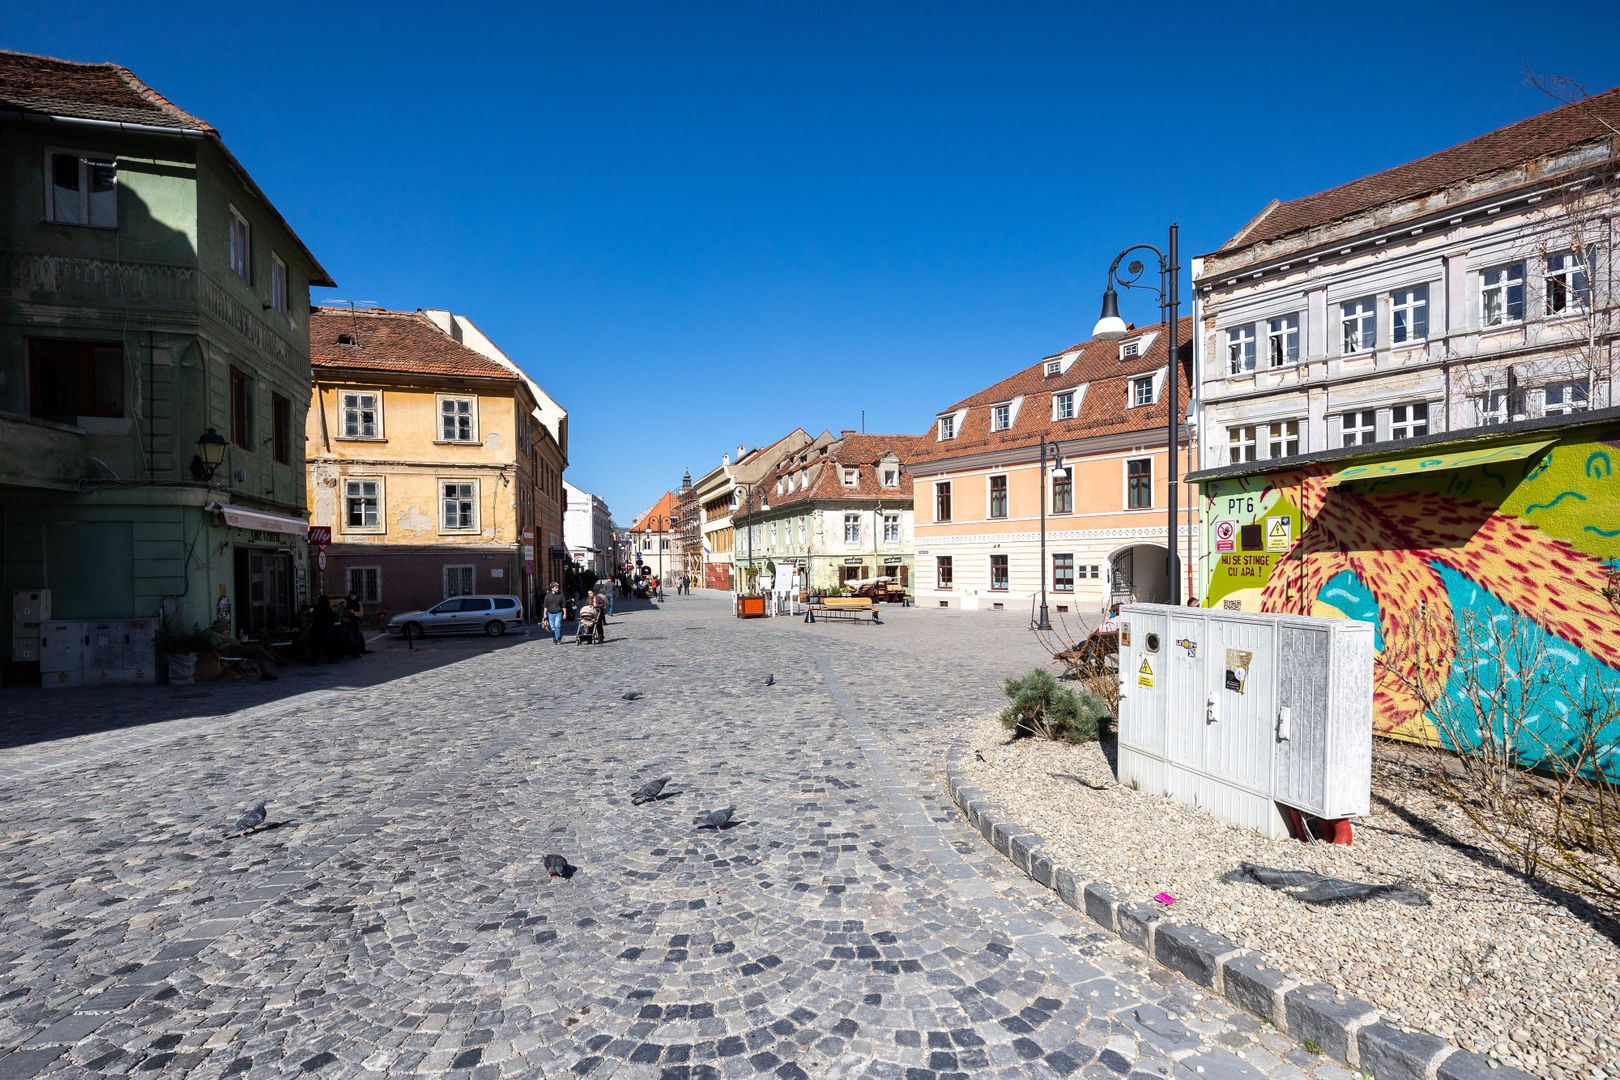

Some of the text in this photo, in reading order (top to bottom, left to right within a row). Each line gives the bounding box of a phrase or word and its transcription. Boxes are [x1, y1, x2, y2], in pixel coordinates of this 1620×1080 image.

[310, 528, 330, 543] illy
[1222, 555, 1269, 566] NU SE STINGE
[1228, 567, 1238, 576] CU
